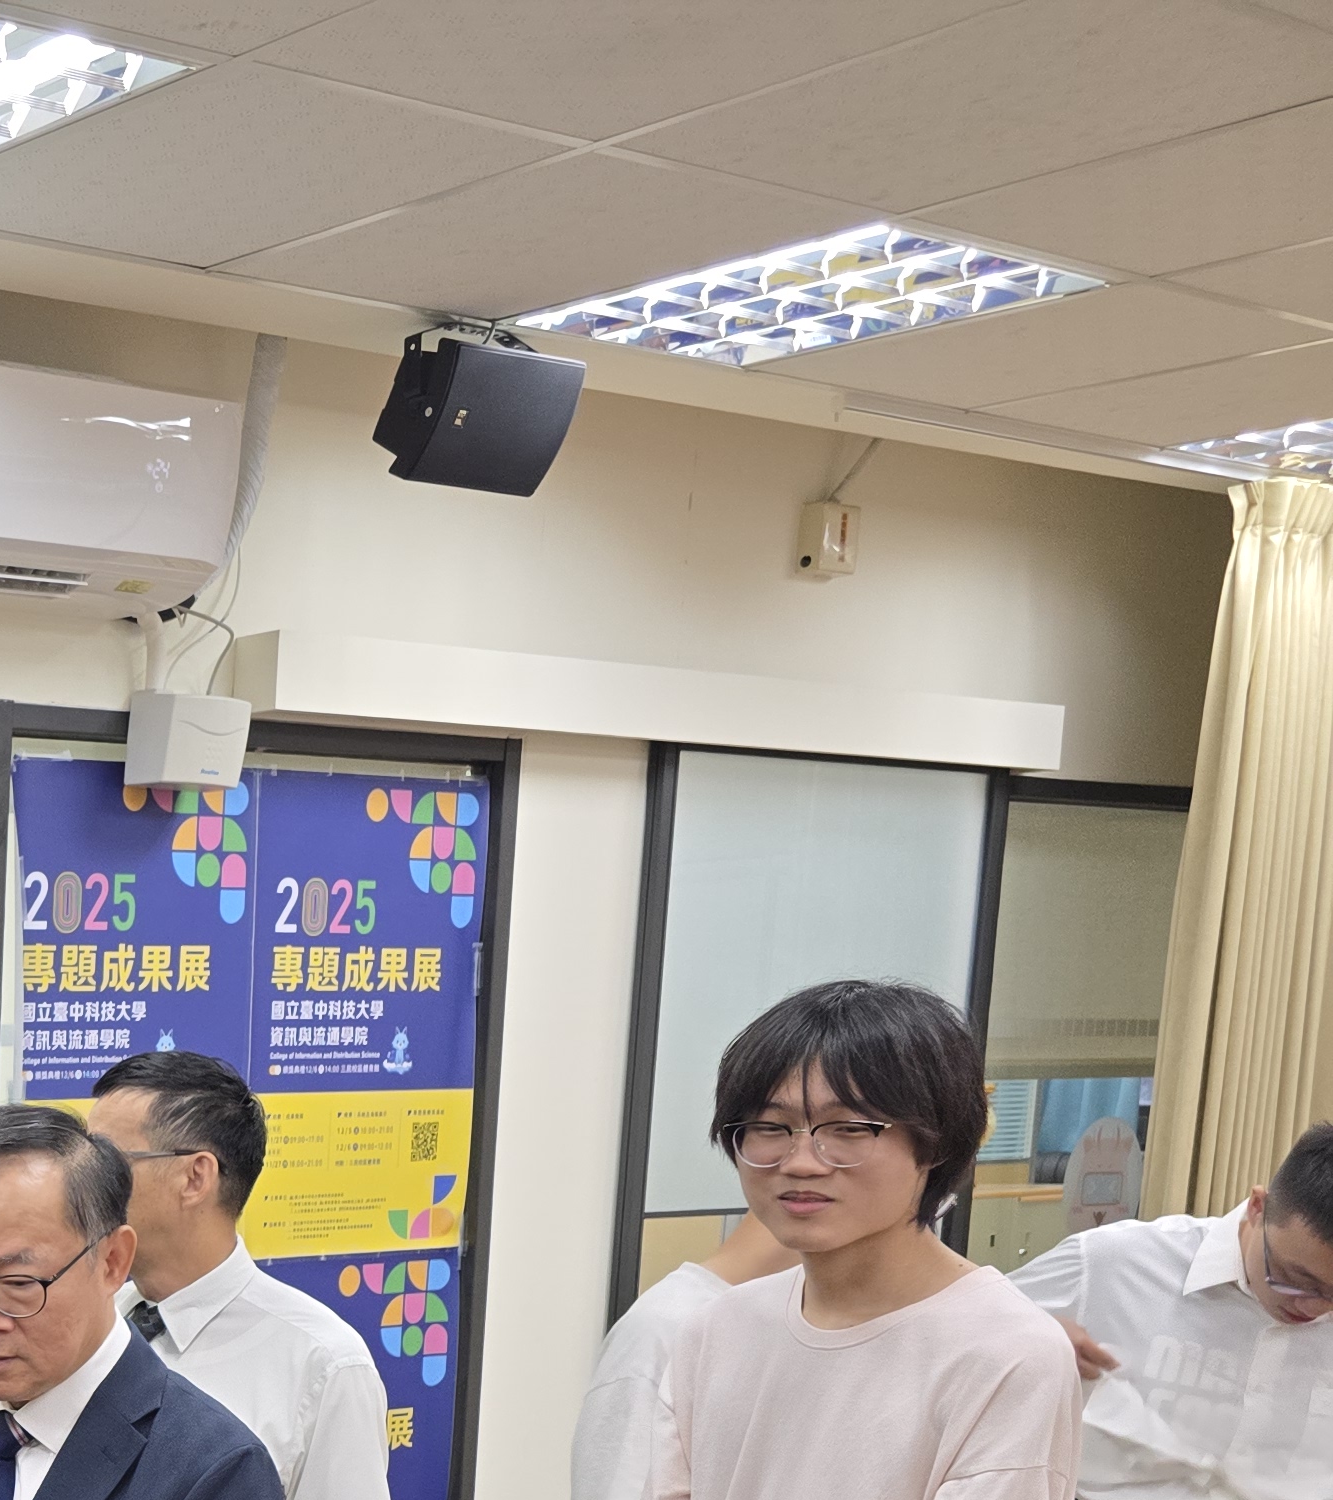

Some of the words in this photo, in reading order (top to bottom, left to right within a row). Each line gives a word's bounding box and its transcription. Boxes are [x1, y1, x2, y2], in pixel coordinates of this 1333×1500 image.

[23, 871, 136, 933] 2025
[274, 877, 376, 936] 2025
[22, 943, 211, 993] 專題成果展
[270, 945, 441, 993] 專題成果展
[23, 1001, 146, 1022] 國立臺中科技大學
[271, 1000, 383, 1020] 國立臺中科技大學
[22, 1029, 130, 1050] 資訊與流通學院
[270, 1026, 368, 1047] 資訊與流通學院
